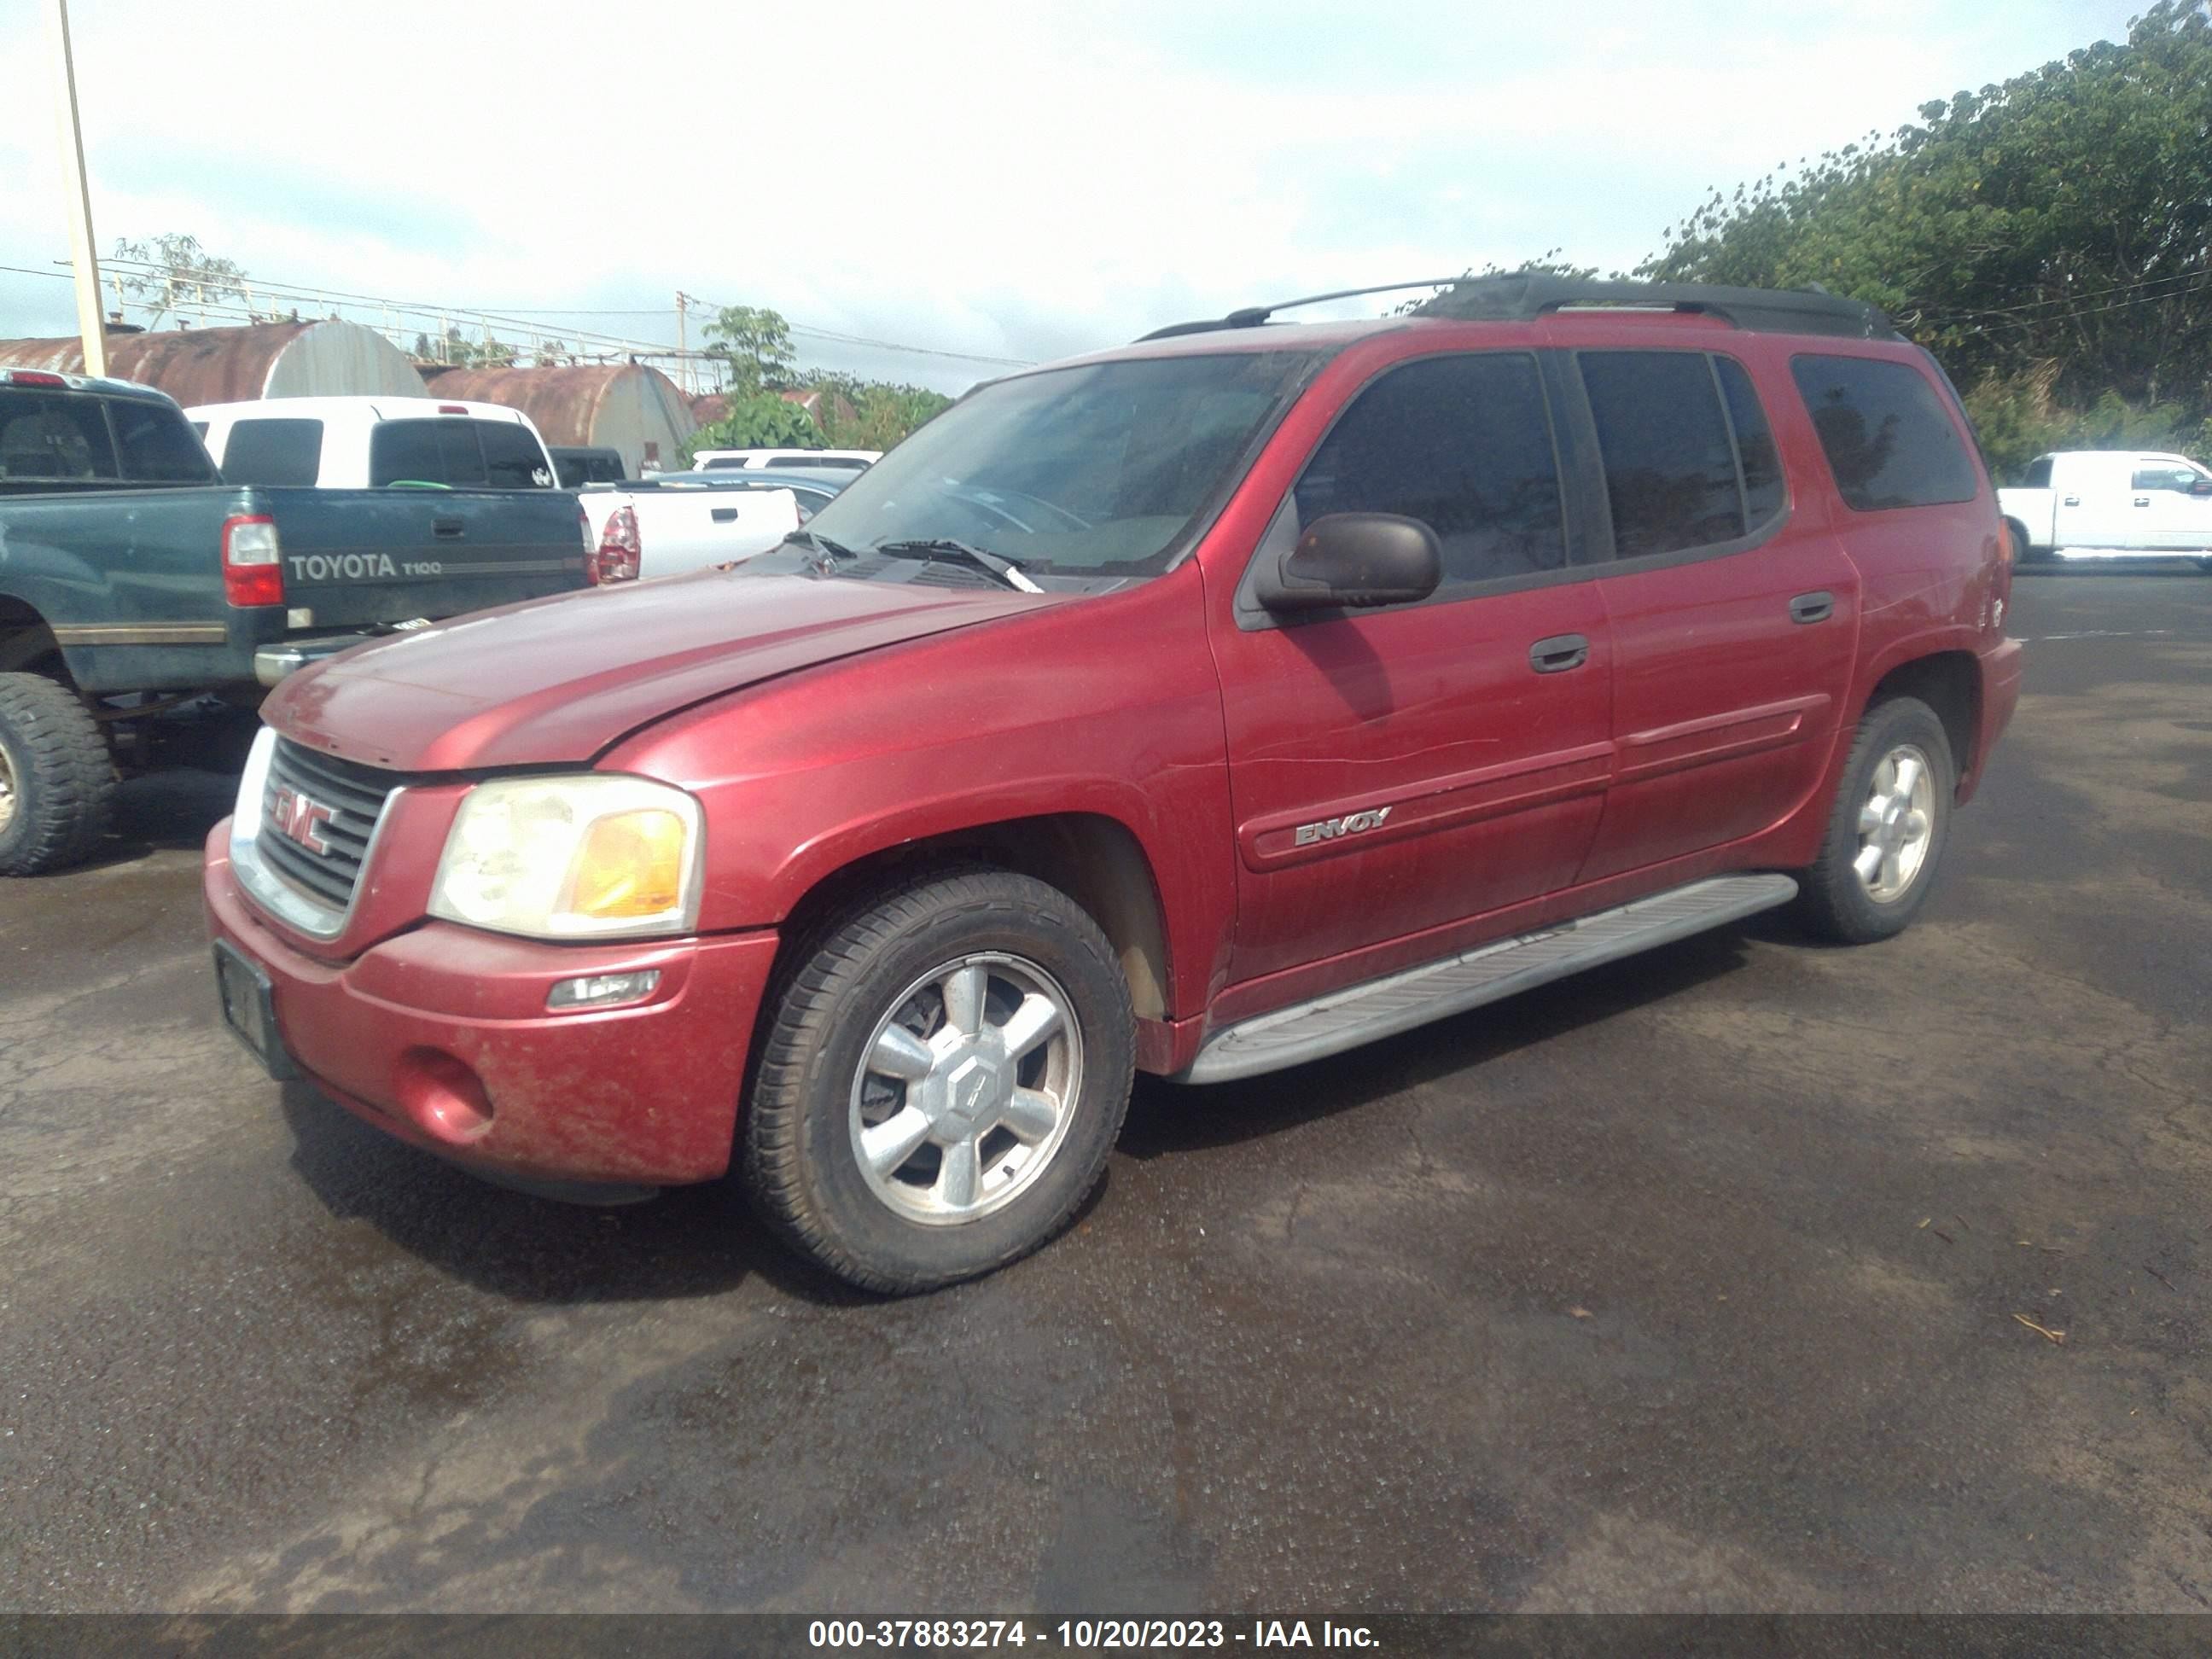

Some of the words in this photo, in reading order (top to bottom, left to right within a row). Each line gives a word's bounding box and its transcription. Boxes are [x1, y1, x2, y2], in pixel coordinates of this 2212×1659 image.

[288, 553, 397, 580] TOYOTA
[401, 561, 442, 575] T100
[271, 784, 339, 856] GMC
[1294, 806, 1393, 847] ENVOY
